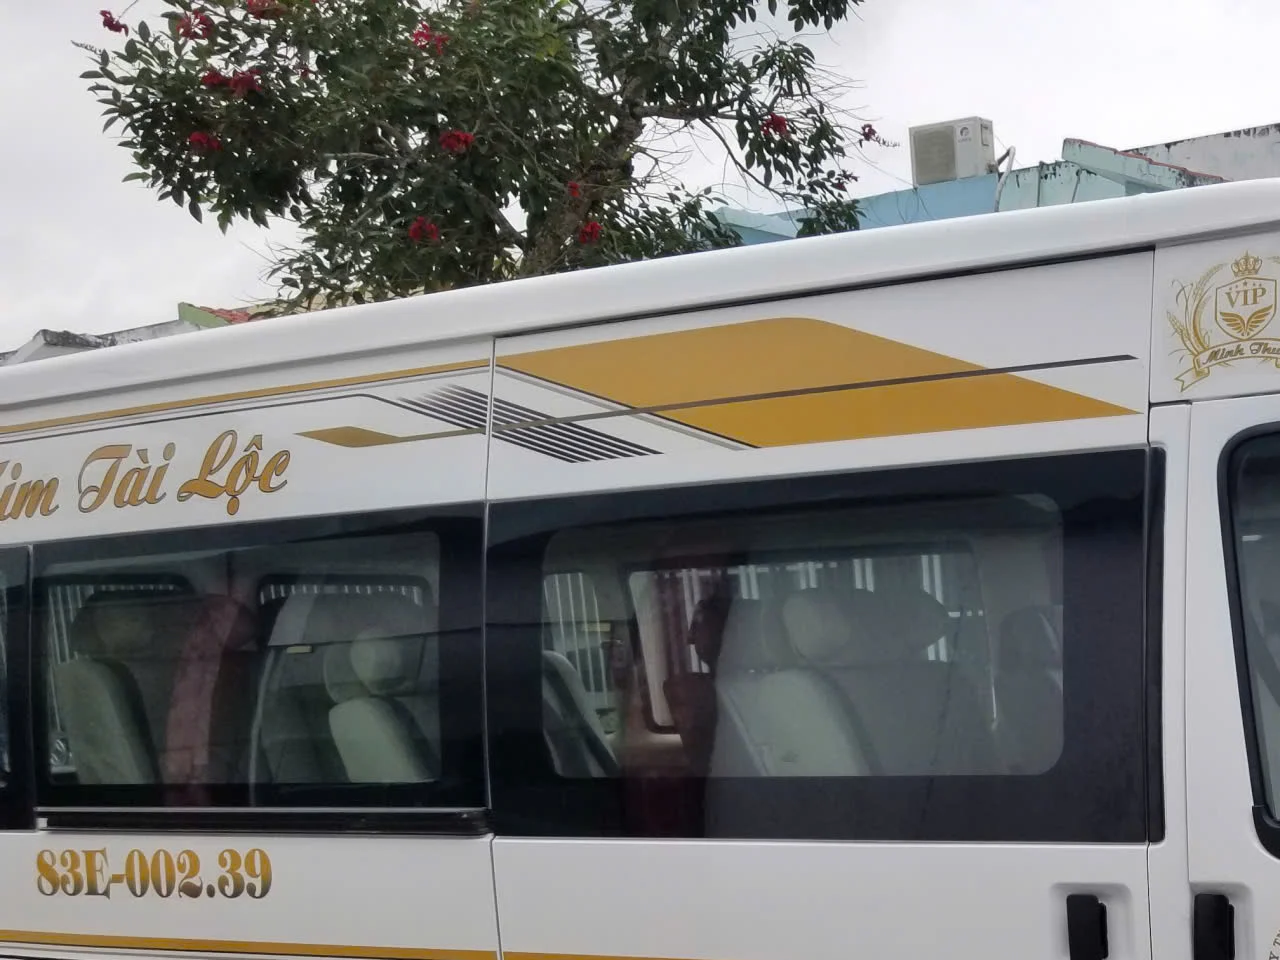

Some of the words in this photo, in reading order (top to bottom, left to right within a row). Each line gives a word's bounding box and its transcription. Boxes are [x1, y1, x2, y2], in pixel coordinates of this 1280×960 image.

[1225, 287, 1267, 308] VIP
[78, 442, 176, 513] Tài
[177, 430, 290, 516] Lộc
[36, 848, 273, 900] 83E-002.39
